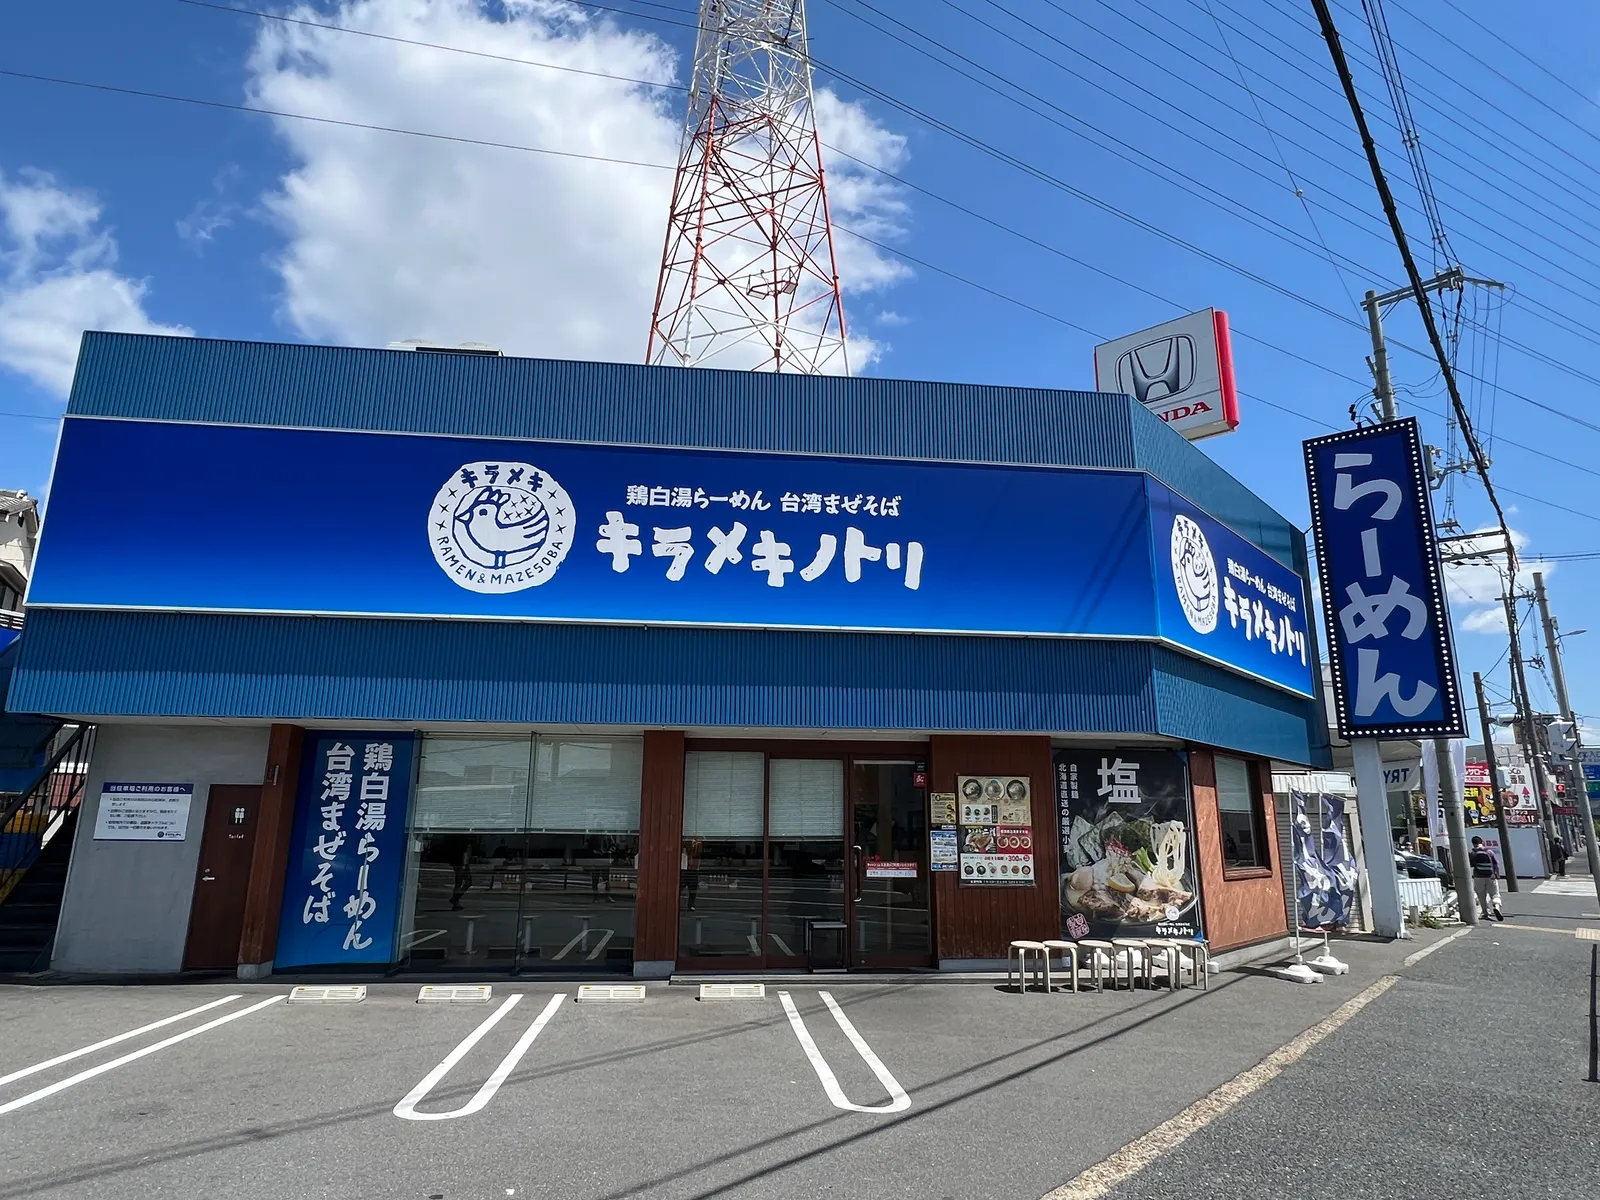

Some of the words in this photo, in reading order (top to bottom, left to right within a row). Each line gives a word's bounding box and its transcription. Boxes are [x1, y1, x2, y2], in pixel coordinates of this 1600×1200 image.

[461, 464, 544, 492] キラメキ
[626, 484, 771, 512] 鶏白湯らーめん
[780, 492, 902, 517] 台湾まぜそば
[597, 511, 923, 590] キラメキノトリ
[1176, 518, 1204, 548] キラメキ
[1227, 557, 1267, 594] 鶏白湯らーめん
[1267, 583, 1296, 612] 台湾まぜそば
[1333, 453, 1438, 717] らーめん
[1223, 576, 1306, 667] キラメキノトリ
[1097, 758, 1141, 803] 塩
[303, 742, 355, 924] 台湾まぜそば
[343, 742, 394, 951] 鶏白湯らーめん
[1155, 925, 1194, 936] キラメキノトリ
